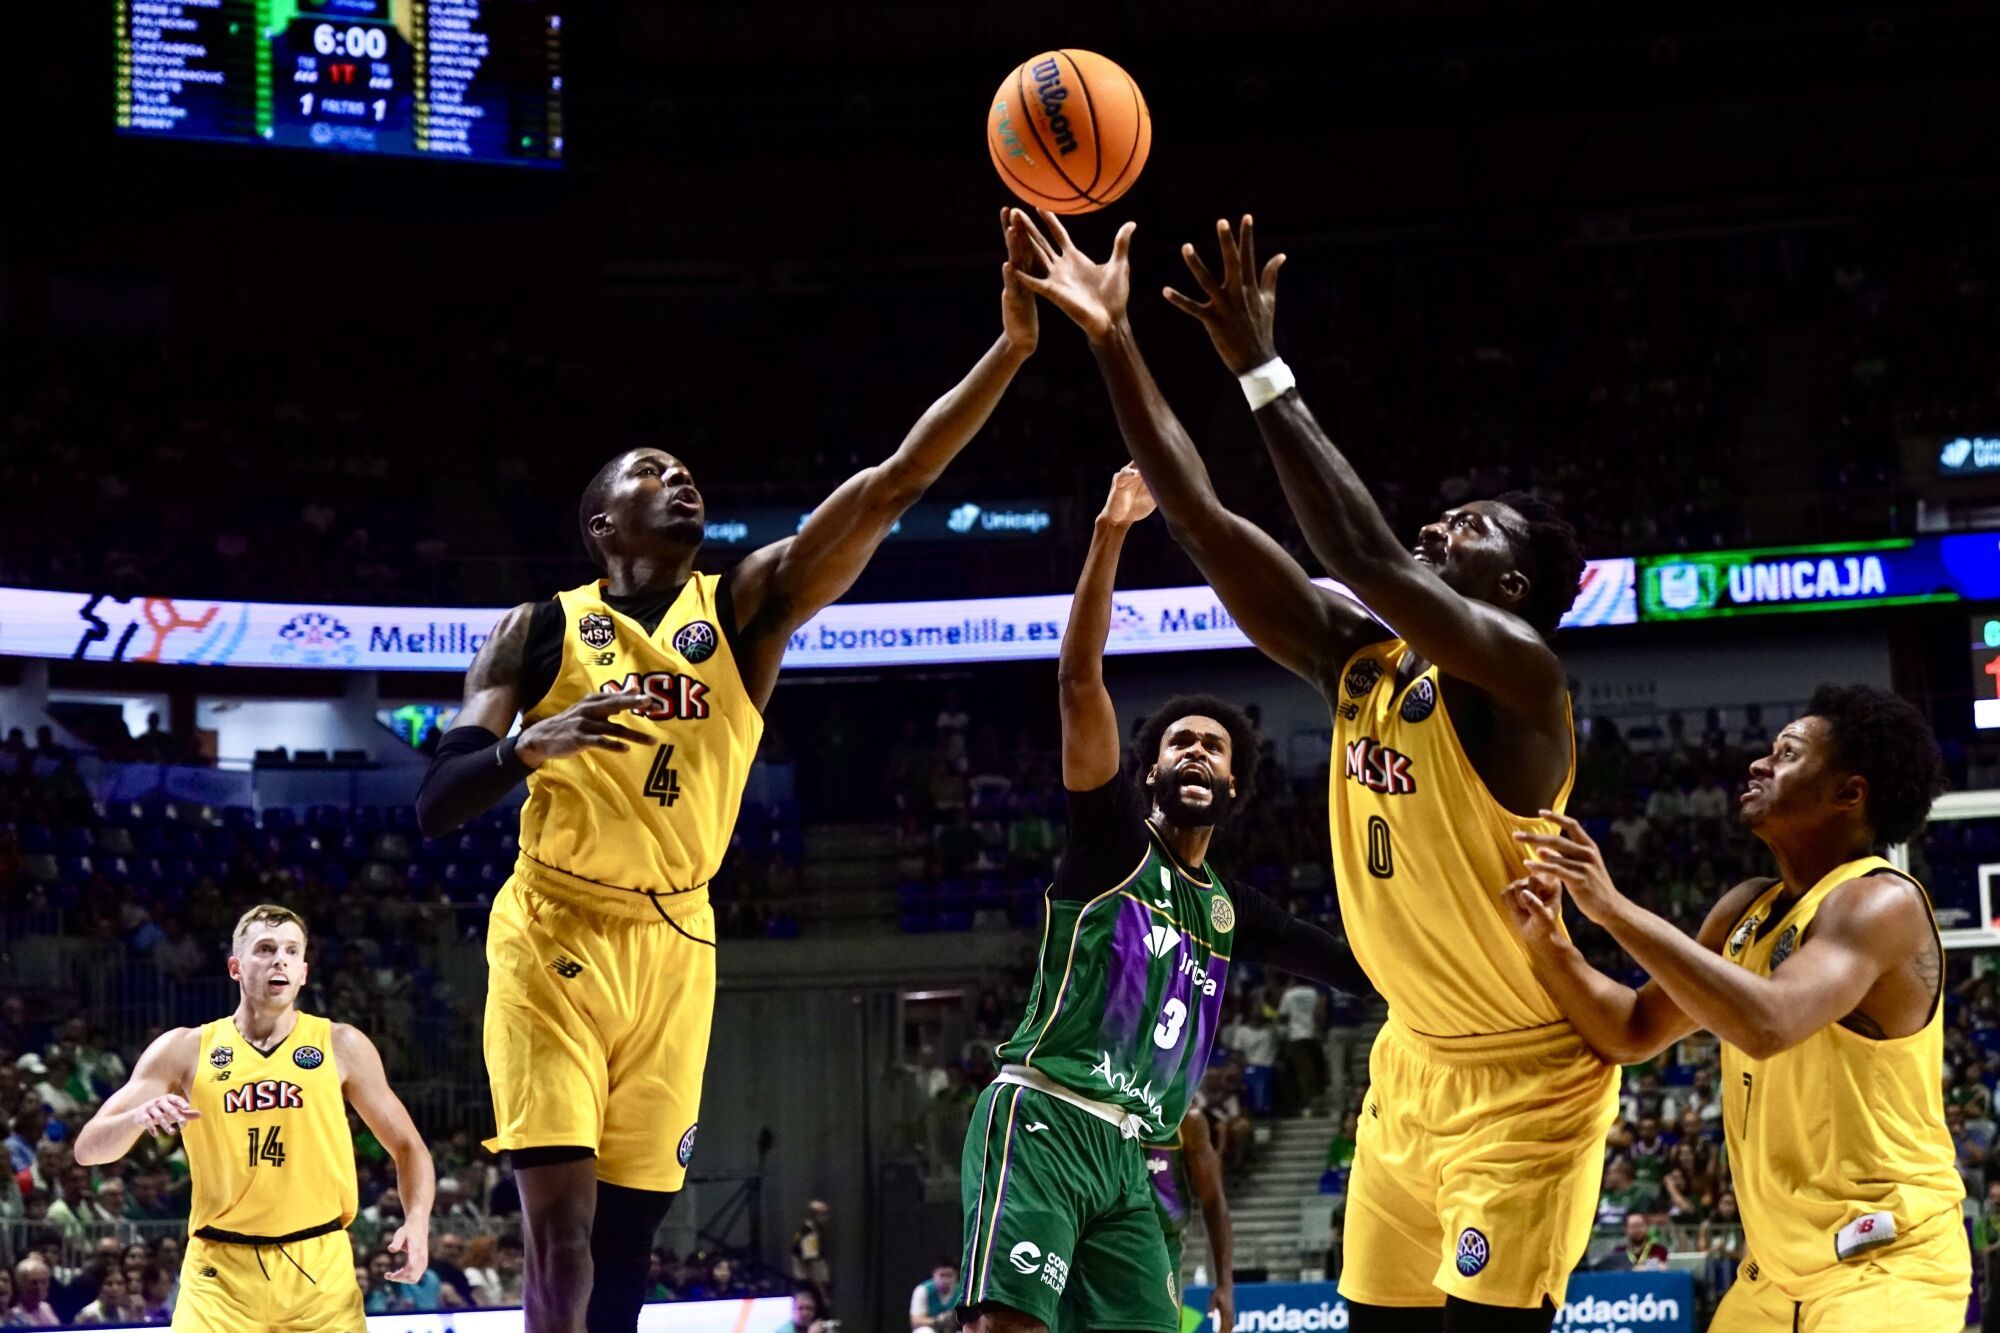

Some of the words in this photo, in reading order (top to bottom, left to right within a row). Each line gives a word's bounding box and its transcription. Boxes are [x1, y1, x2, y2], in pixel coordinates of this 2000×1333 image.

[314, 23, 387, 59] 6:00
[300, 92, 314, 116] 1
[372, 99, 387, 122] 1
[1031, 57, 1079, 157] Wilson
[1728, 556, 1887, 603] UNICAJA
[643, 743, 680, 808] 4
[1345, 736, 1416, 795] MSK
[1368, 815, 1394, 879] 0
[1153, 997, 1187, 1050] 3
[224, 1080, 303, 1113] MSK
[248, 1125, 286, 1167] 14
